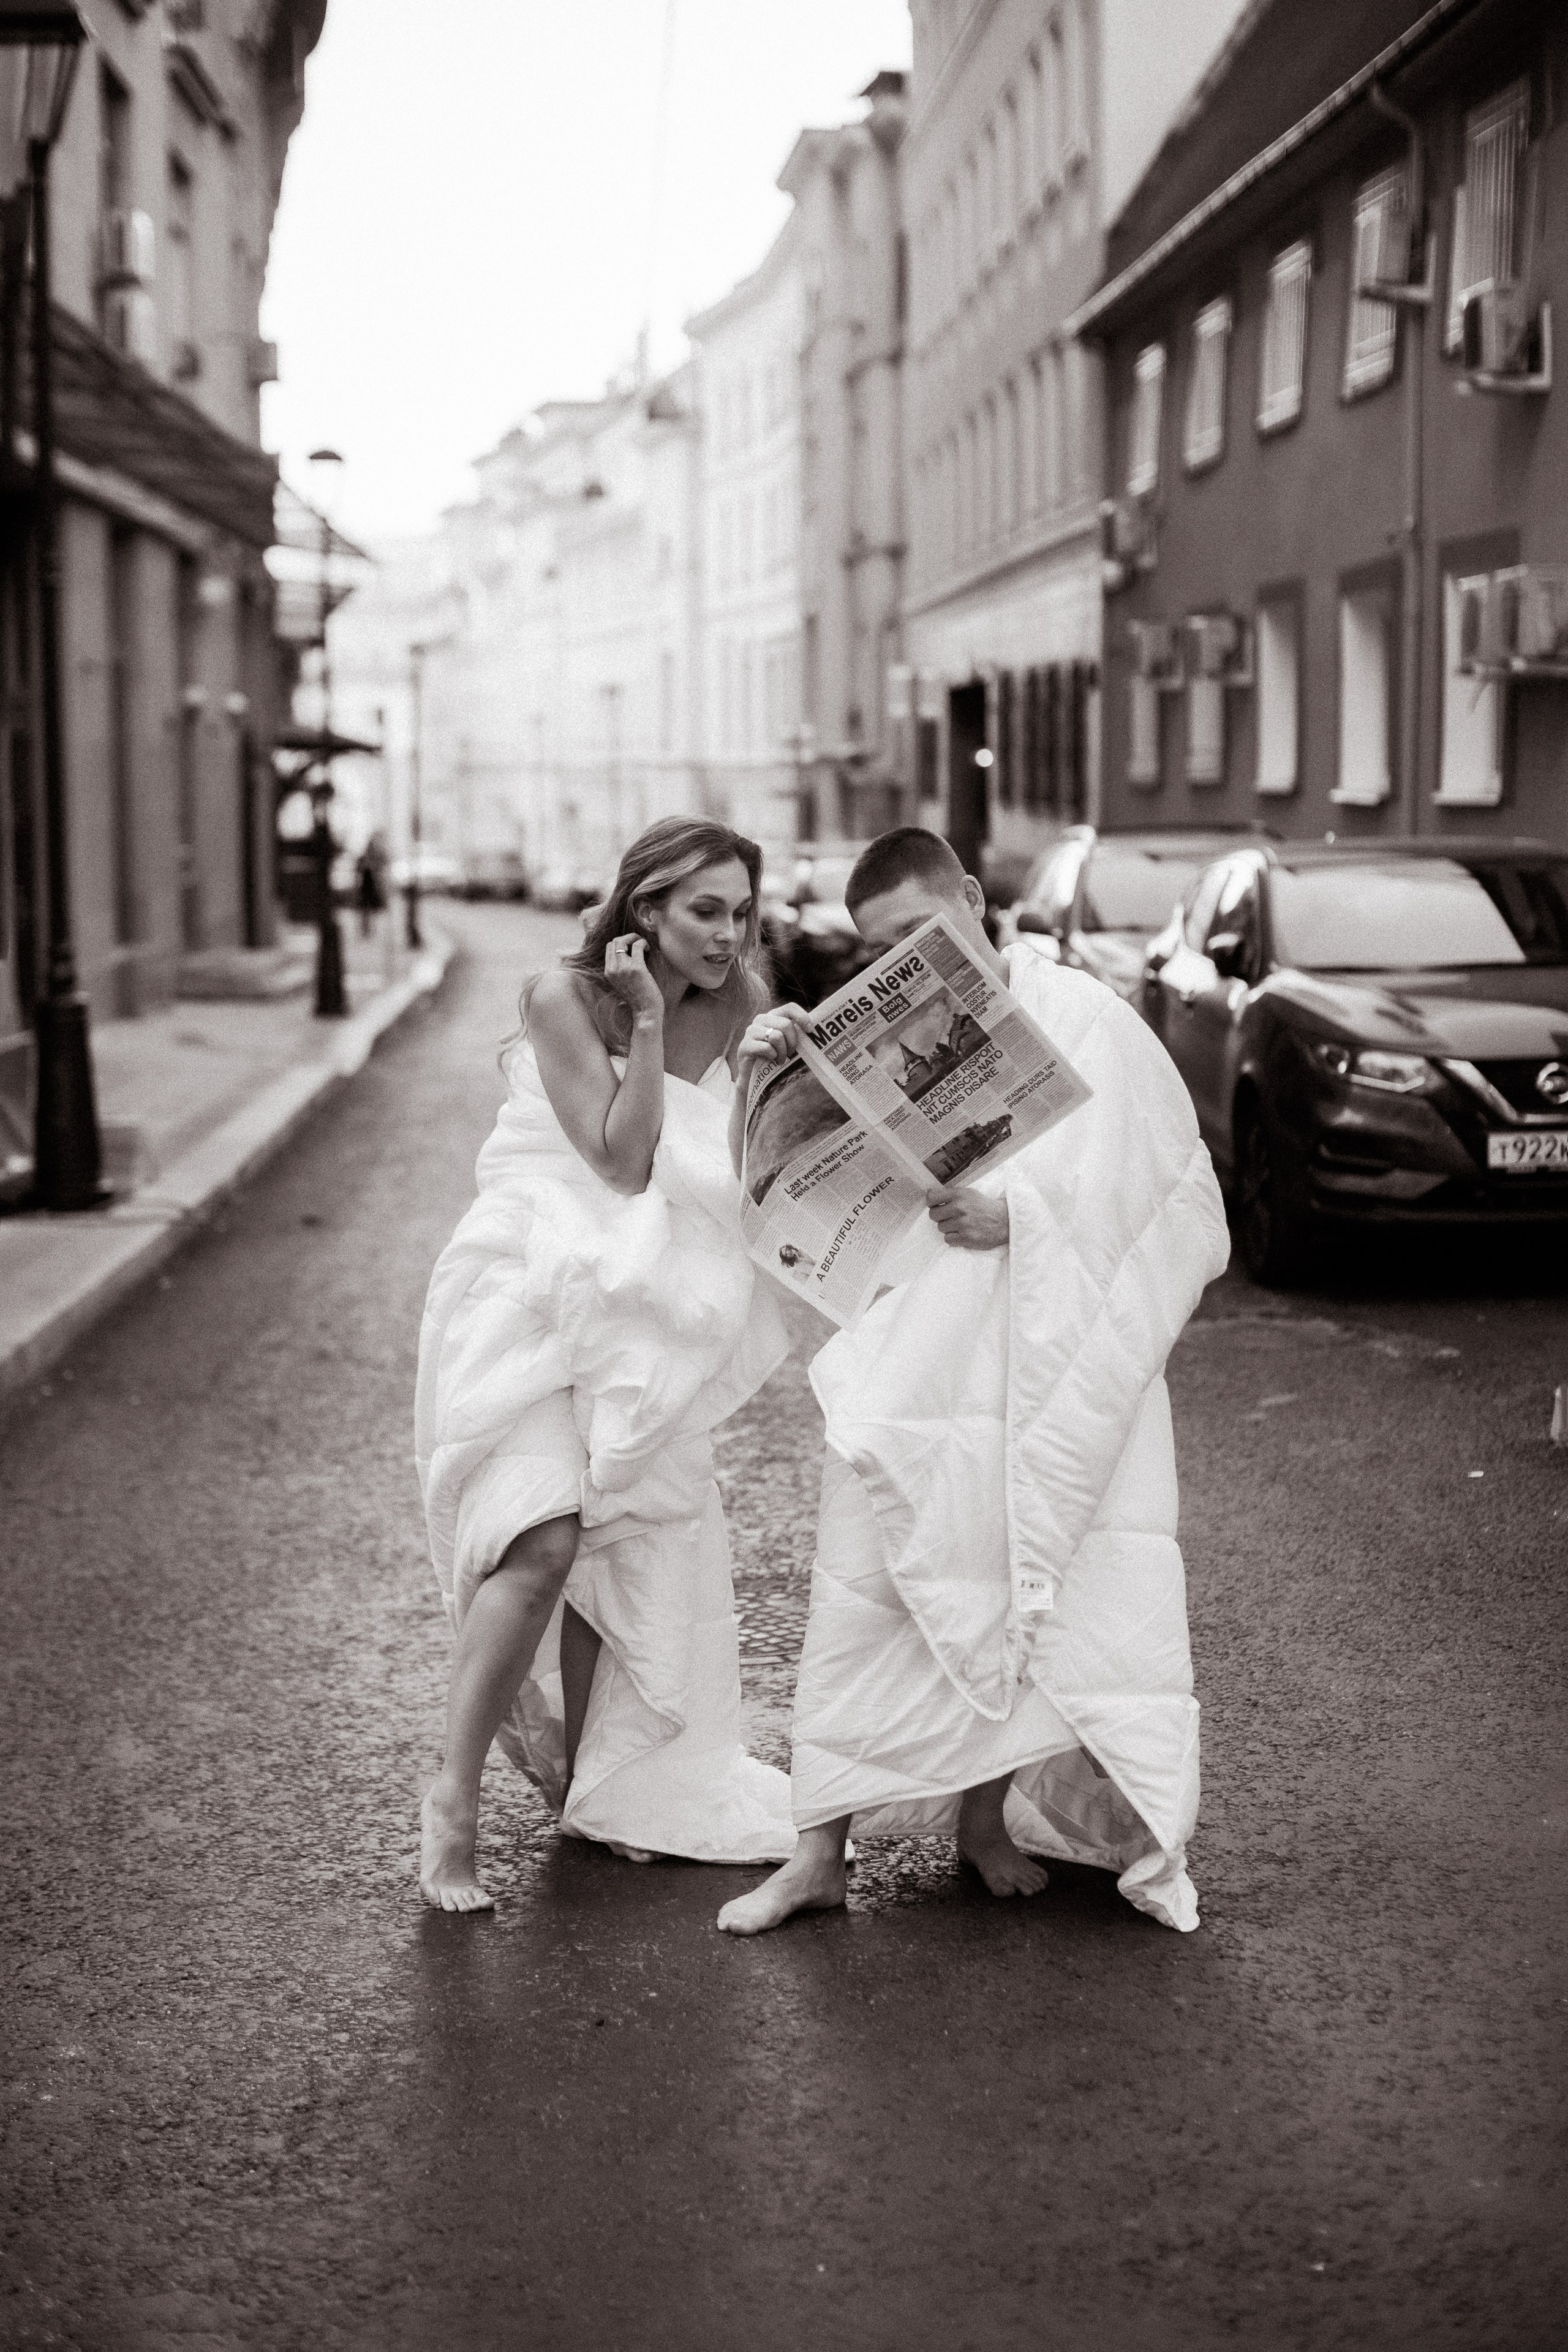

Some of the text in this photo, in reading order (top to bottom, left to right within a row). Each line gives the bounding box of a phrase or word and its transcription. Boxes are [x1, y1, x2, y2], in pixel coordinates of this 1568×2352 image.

[882, 997, 903, 1014] Bolg
[887, 1002, 909, 1020] nwes
[966, 990, 987, 1009] COSTUR
[974, 1006, 989, 1019] DIAM
[806, 996, 873, 1050] Mareis
[828, 1038, 852, 1061] NAWS
[839, 1052, 864, 1073] HEADLINE
[842, 1064, 858, 1077] DURS
[846, 1069, 861, 1082] ISING
[850, 1065, 873, 1085] ATORASA
[938, 1070, 979, 1104] CUMSCIS
[977, 1050, 1003, 1073] NATO
[1003, 1060, 1057, 1104] HEADING DURS TAID
[916, 1071, 962, 1110] HEADLINE
[929, 1093, 965, 1125] MAGNIS
[964, 1066, 1000, 1096] DISARE
[1007, 1091, 1028, 1109] IPISING
[1028, 1070, 1055, 1094] ATORASIS
[784, 1130, 868, 1195] Last week Nature Park
[791, 1185, 810, 1202] Held
[815, 1161, 843, 1182] Flower
[842, 1144, 865, 1163] Show
[816, 1177, 895, 1283] A BEAUTIFUL FLOWER
